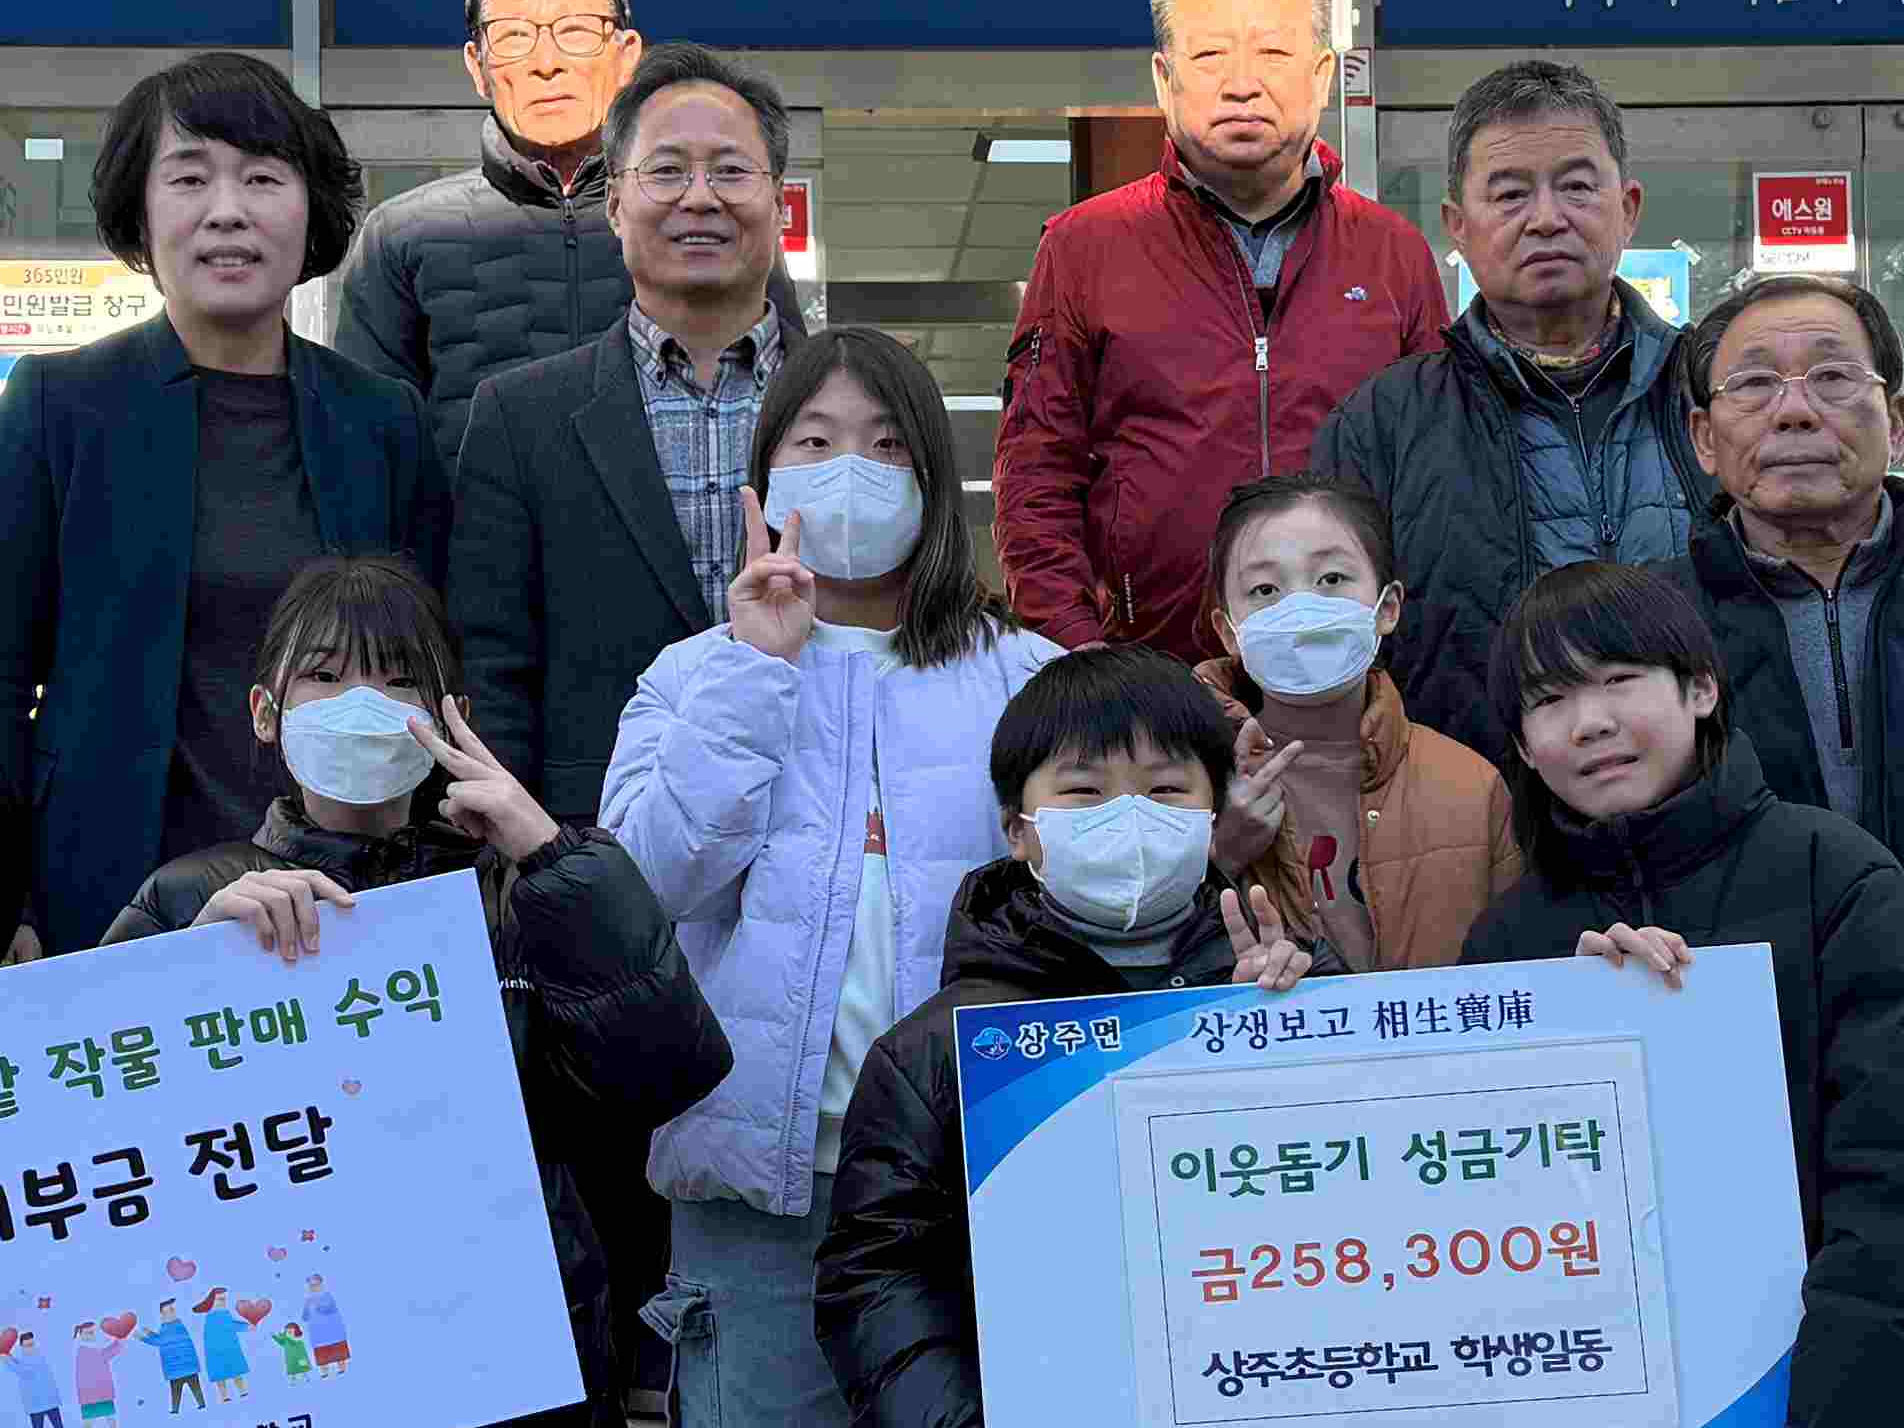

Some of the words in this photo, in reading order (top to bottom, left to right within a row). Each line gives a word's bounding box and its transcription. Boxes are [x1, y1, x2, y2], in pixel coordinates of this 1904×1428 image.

[1772, 197, 1832, 221] 에스원
[104, 294, 146, 318] 창구
[46, 1025, 162, 1098] 작물
[185, 997, 309, 1071] 판매
[335, 963, 443, 1038] 수익
[1015, 1018, 1121, 1059] 상주면
[1191, 1007, 1354, 1055] 상생보고
[1373, 988, 1536, 1039] 相生寶庫
[185, 1104, 336, 1202] 전달
[1169, 1134, 1370, 1200] 이웃돕기
[1401, 1119, 1608, 1189] 성금기탁
[1191, 1218, 1602, 1304] 금258,300원
[1202, 1336, 1440, 1399] 상주초등학교
[1451, 1325, 1614, 1382] 학생일동
